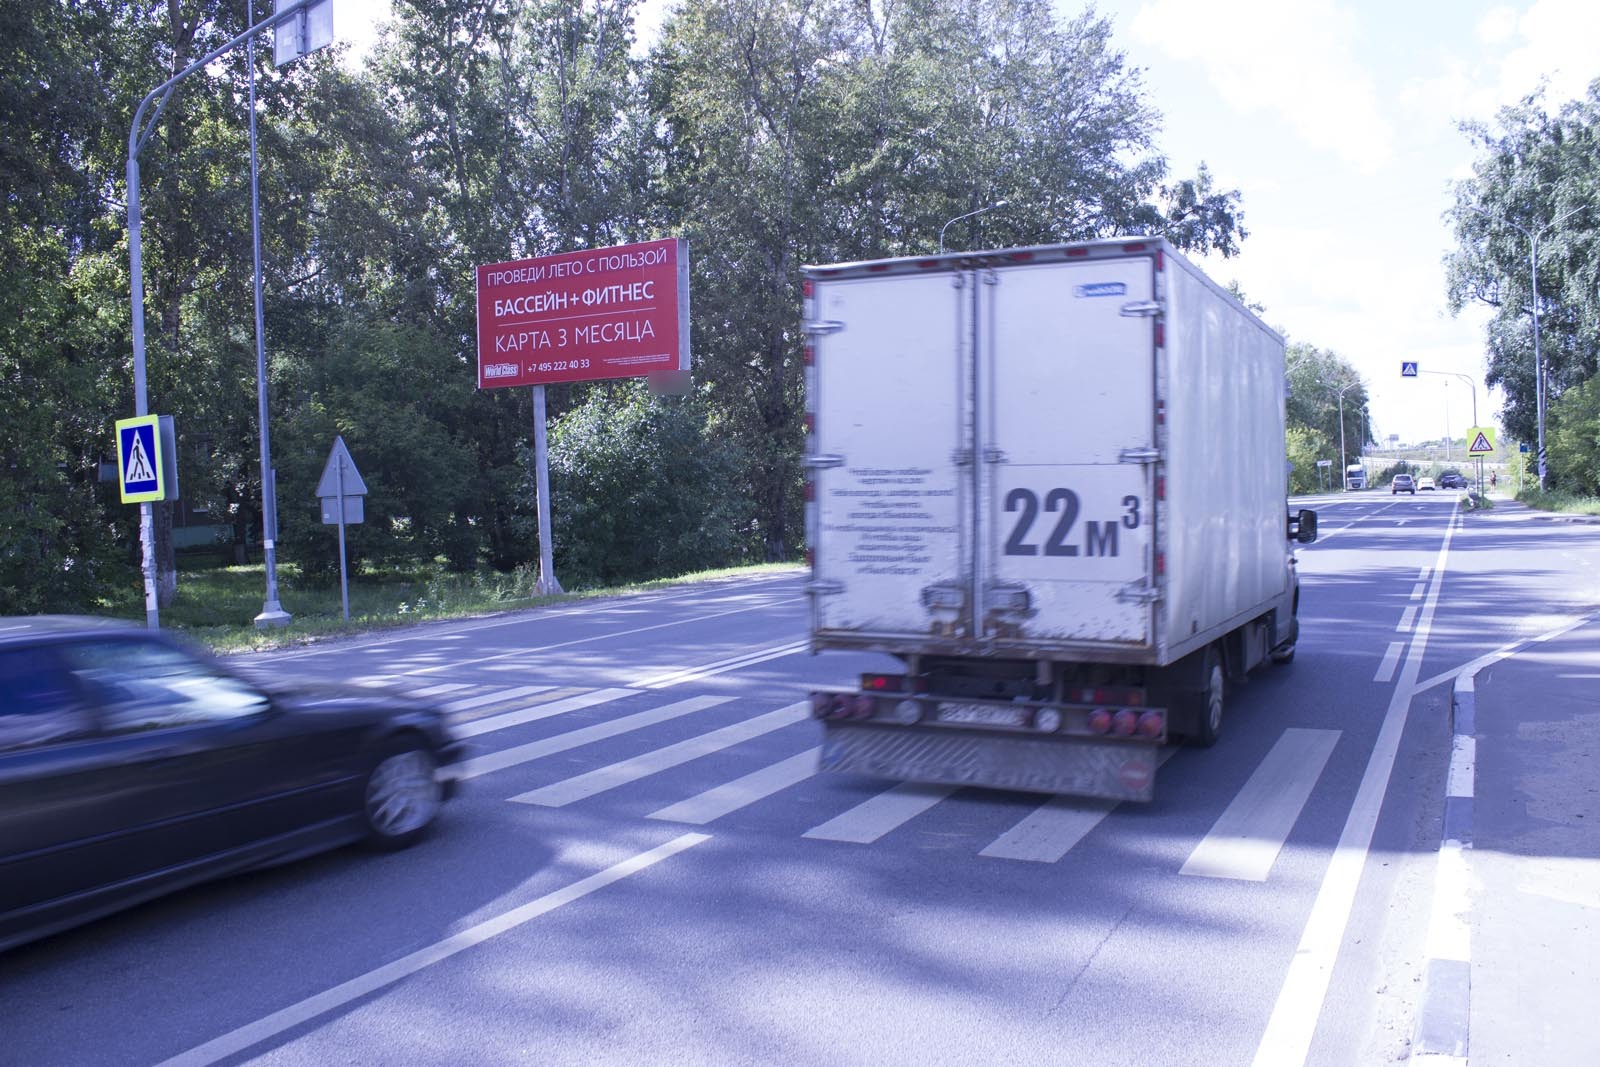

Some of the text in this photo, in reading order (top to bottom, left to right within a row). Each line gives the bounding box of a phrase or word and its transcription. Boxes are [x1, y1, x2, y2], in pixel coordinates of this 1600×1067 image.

[487, 247, 667, 286] ПРОВЕДИ ЛЕТО С ПОЛЬЗОЙ
[495, 319, 655, 352] КАРТА 3 МЕСЯЦА
[485, 364, 517, 377] World Class
[538, 362, 551, 372] 495
[553, 361, 567, 371] 222
[568, 359, 579, 369] 40
[580, 358, 590, 368] 33
